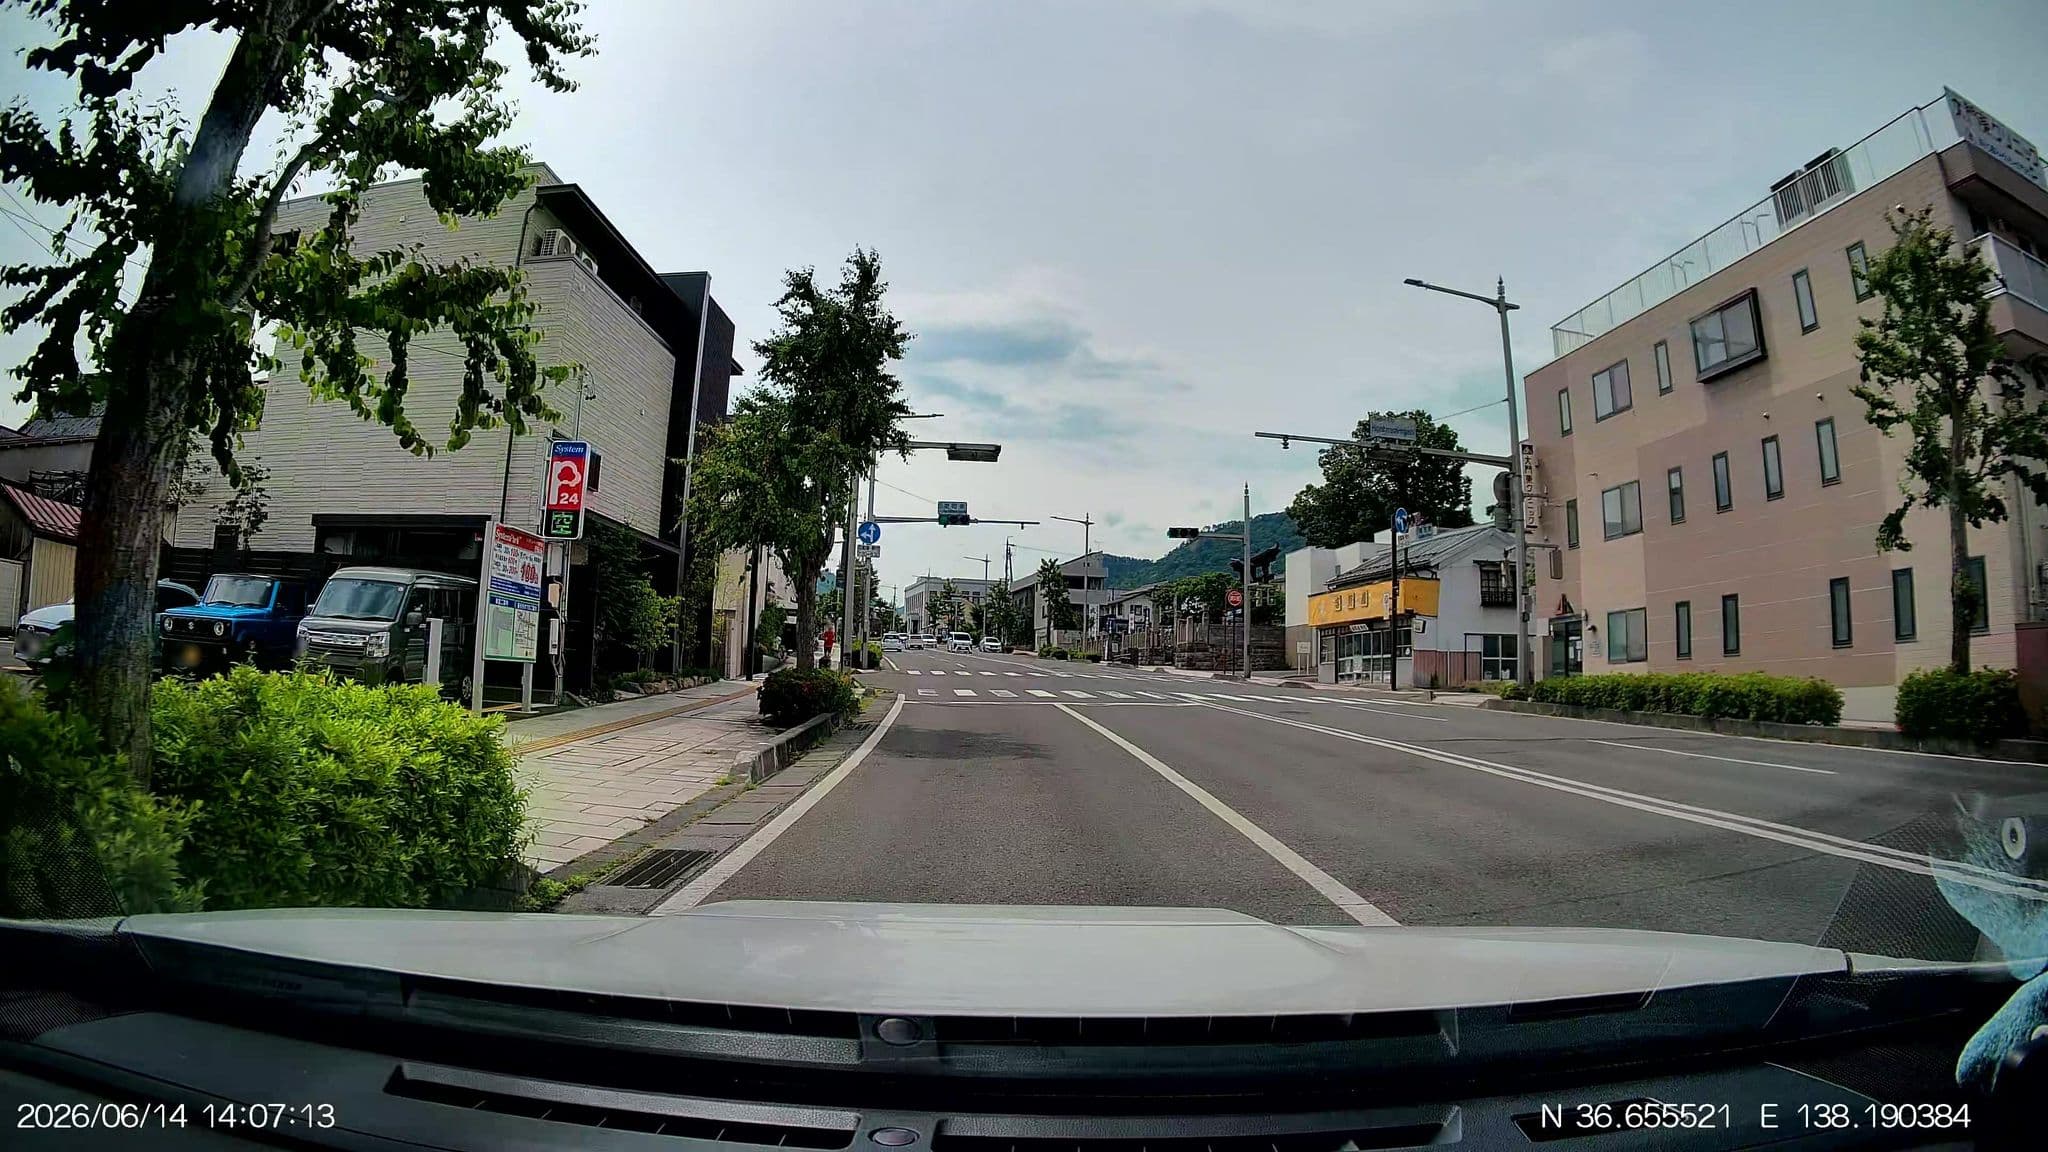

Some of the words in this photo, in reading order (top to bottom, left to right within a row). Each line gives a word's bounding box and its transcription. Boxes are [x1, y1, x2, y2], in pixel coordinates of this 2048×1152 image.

[554, 444, 584, 455] System
[560, 492, 579, 505] 24
[551, 511, 574, 535] 空
